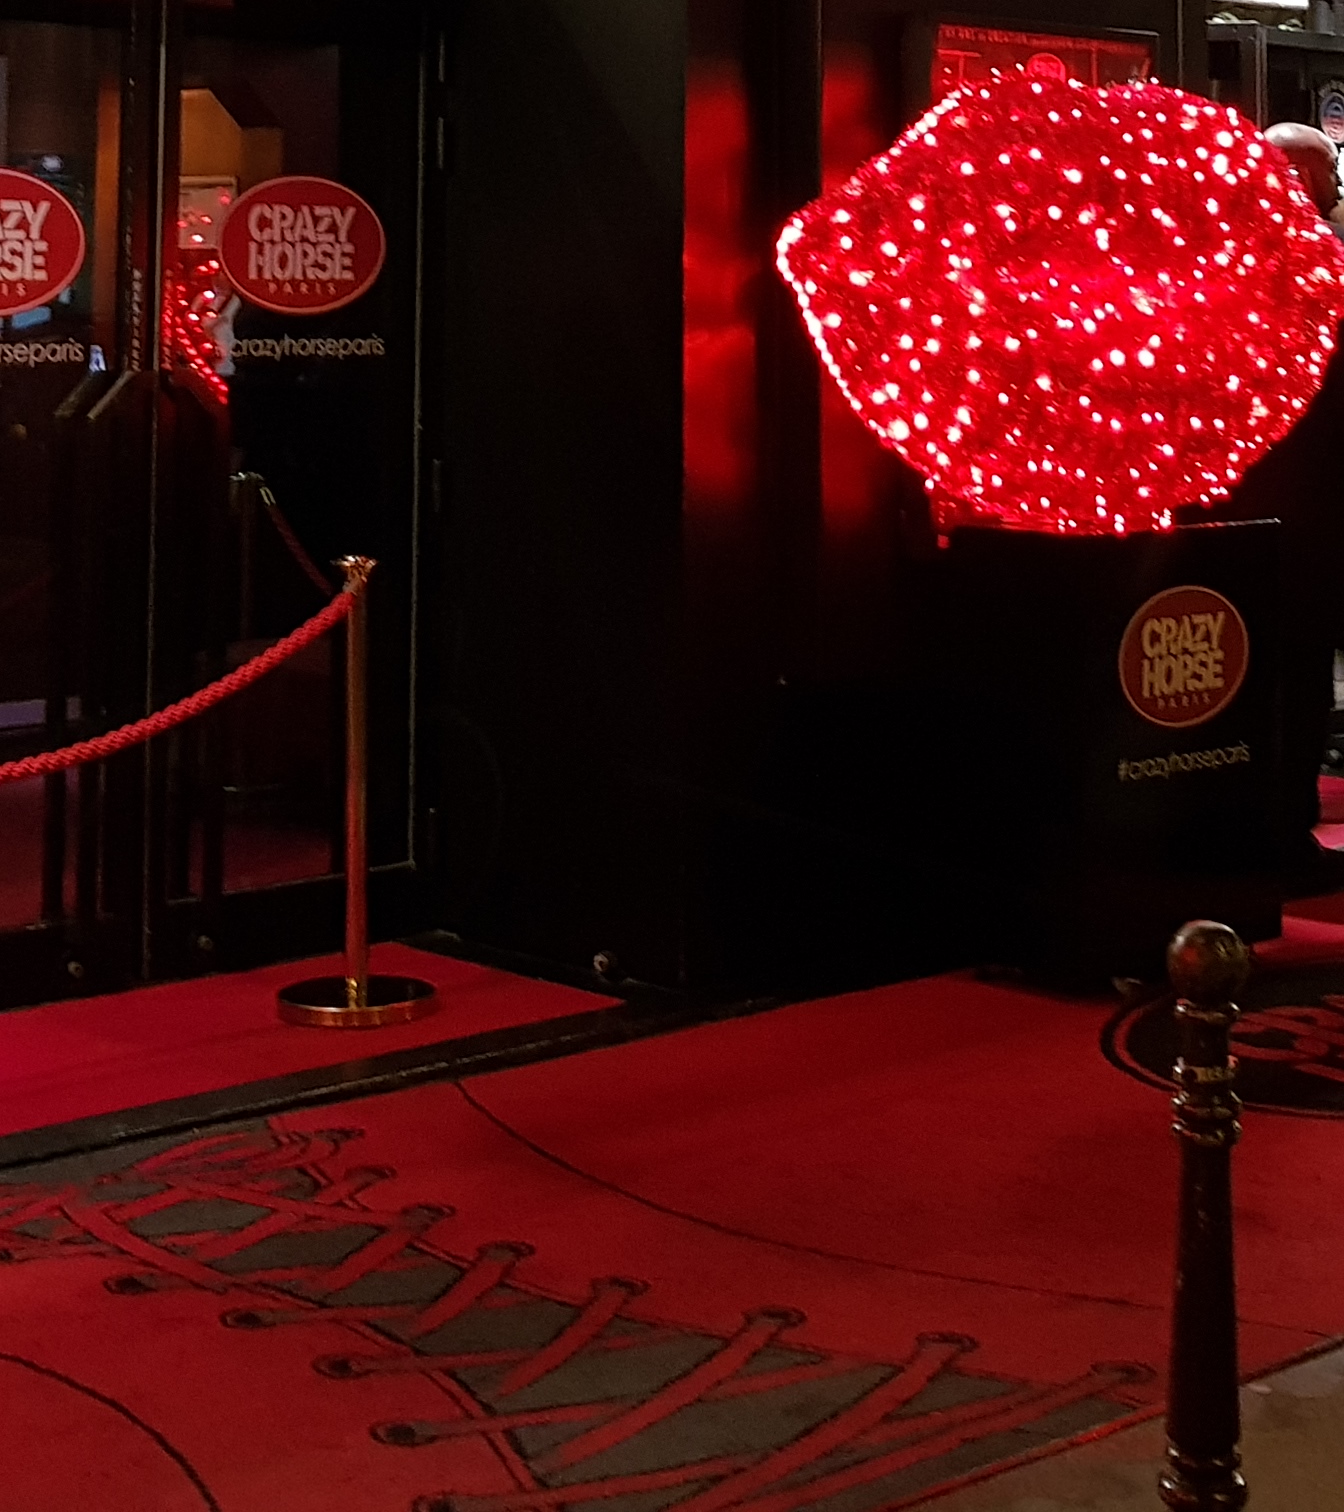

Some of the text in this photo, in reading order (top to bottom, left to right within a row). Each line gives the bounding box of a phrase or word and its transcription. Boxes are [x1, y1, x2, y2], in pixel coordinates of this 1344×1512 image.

[247, 203, 357, 244] CRAZY
[248, 240, 355, 281] HORSE
[268, 281, 337, 296] PARIS
[1140, 611, 1226, 658] CRAZY
[1142, 650, 1225, 698] HORSE
